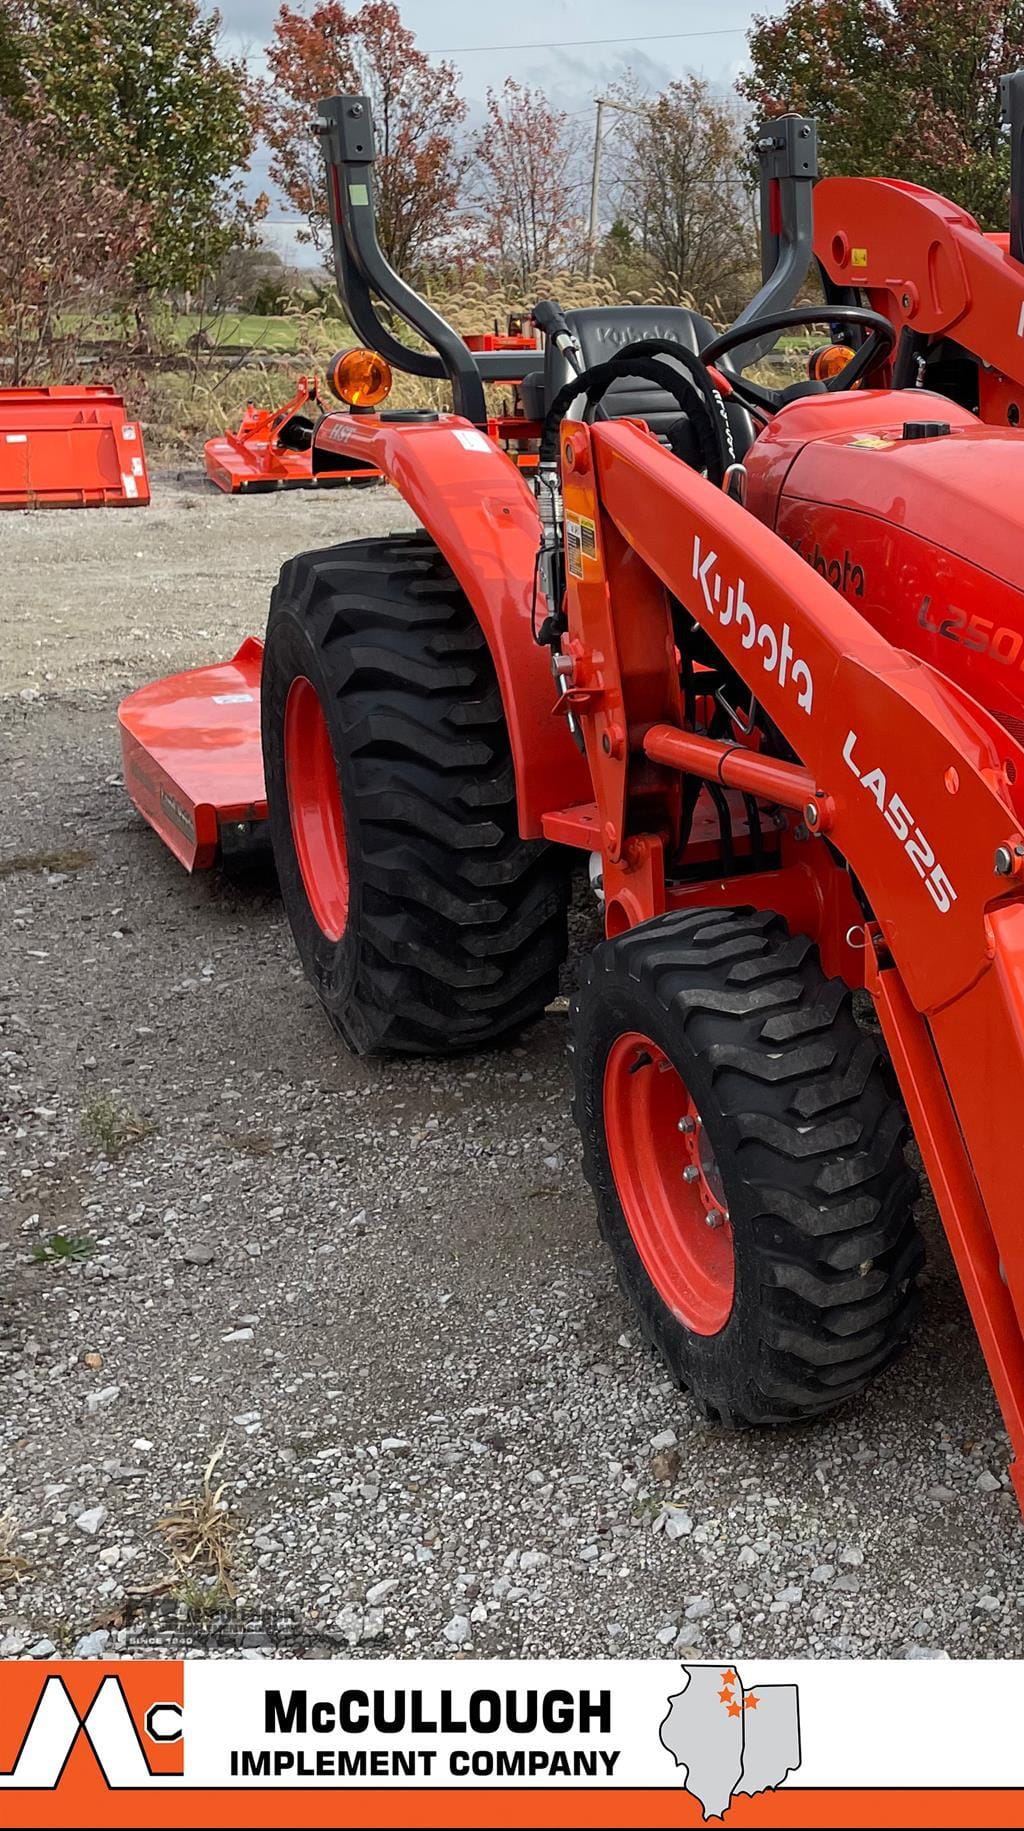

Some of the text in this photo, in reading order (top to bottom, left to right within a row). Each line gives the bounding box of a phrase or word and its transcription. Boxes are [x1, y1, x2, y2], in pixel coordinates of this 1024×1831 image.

[329, 423, 356, 443] HST
[692, 535, 813, 715] Kubota
[842, 730, 958, 913] LA525
